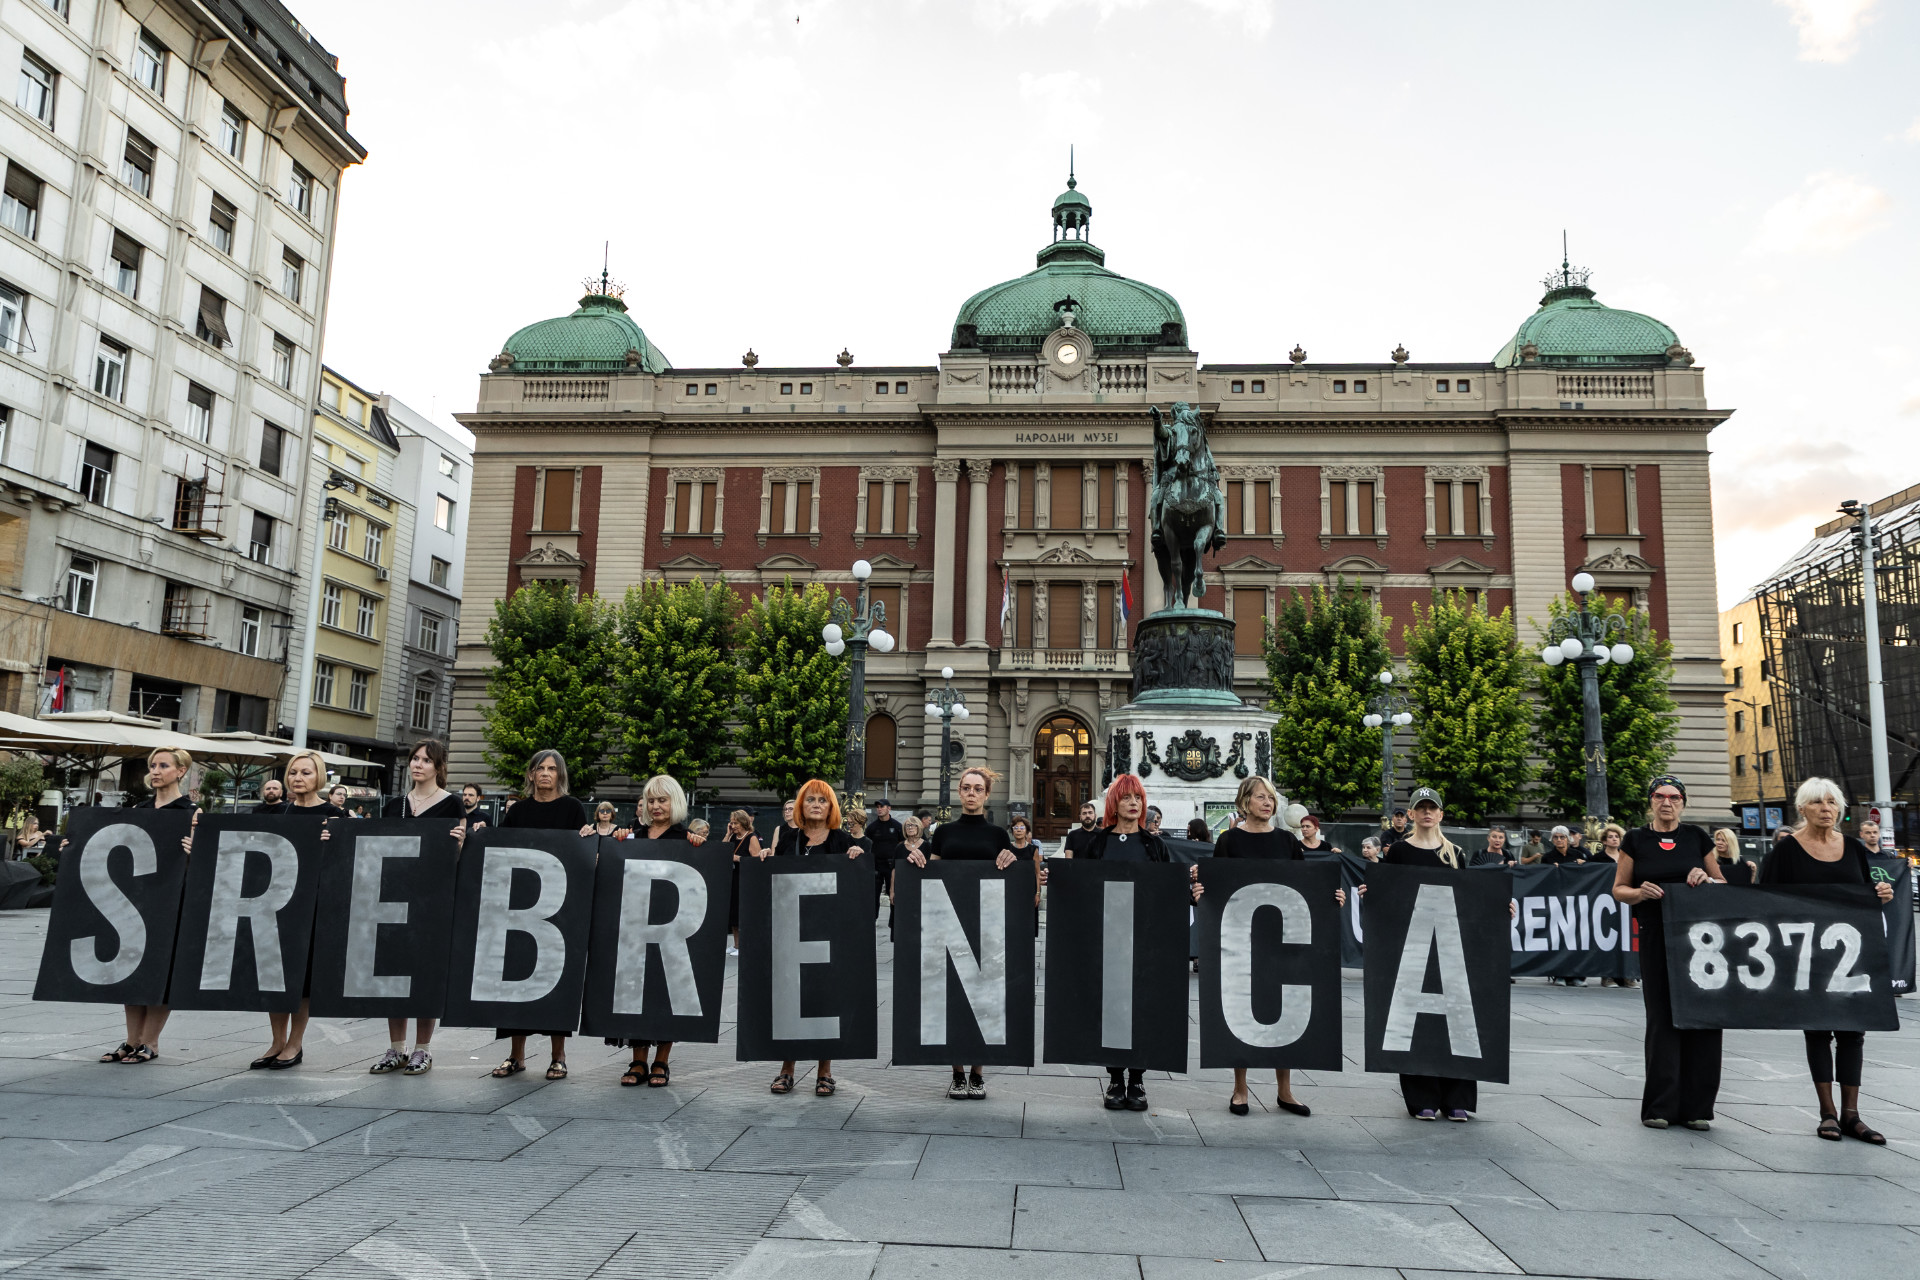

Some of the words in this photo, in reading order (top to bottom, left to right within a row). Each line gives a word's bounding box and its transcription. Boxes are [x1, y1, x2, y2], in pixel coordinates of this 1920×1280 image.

[1016, 433, 1075, 443] НАРОДНИ
[1083, 432, 1119, 443] МУЗЕЈ
[1420, 788, 1430, 797] NY
[70, 823, 1483, 1059] SREBRENICA
[1688, 921, 1872, 993] 8372
